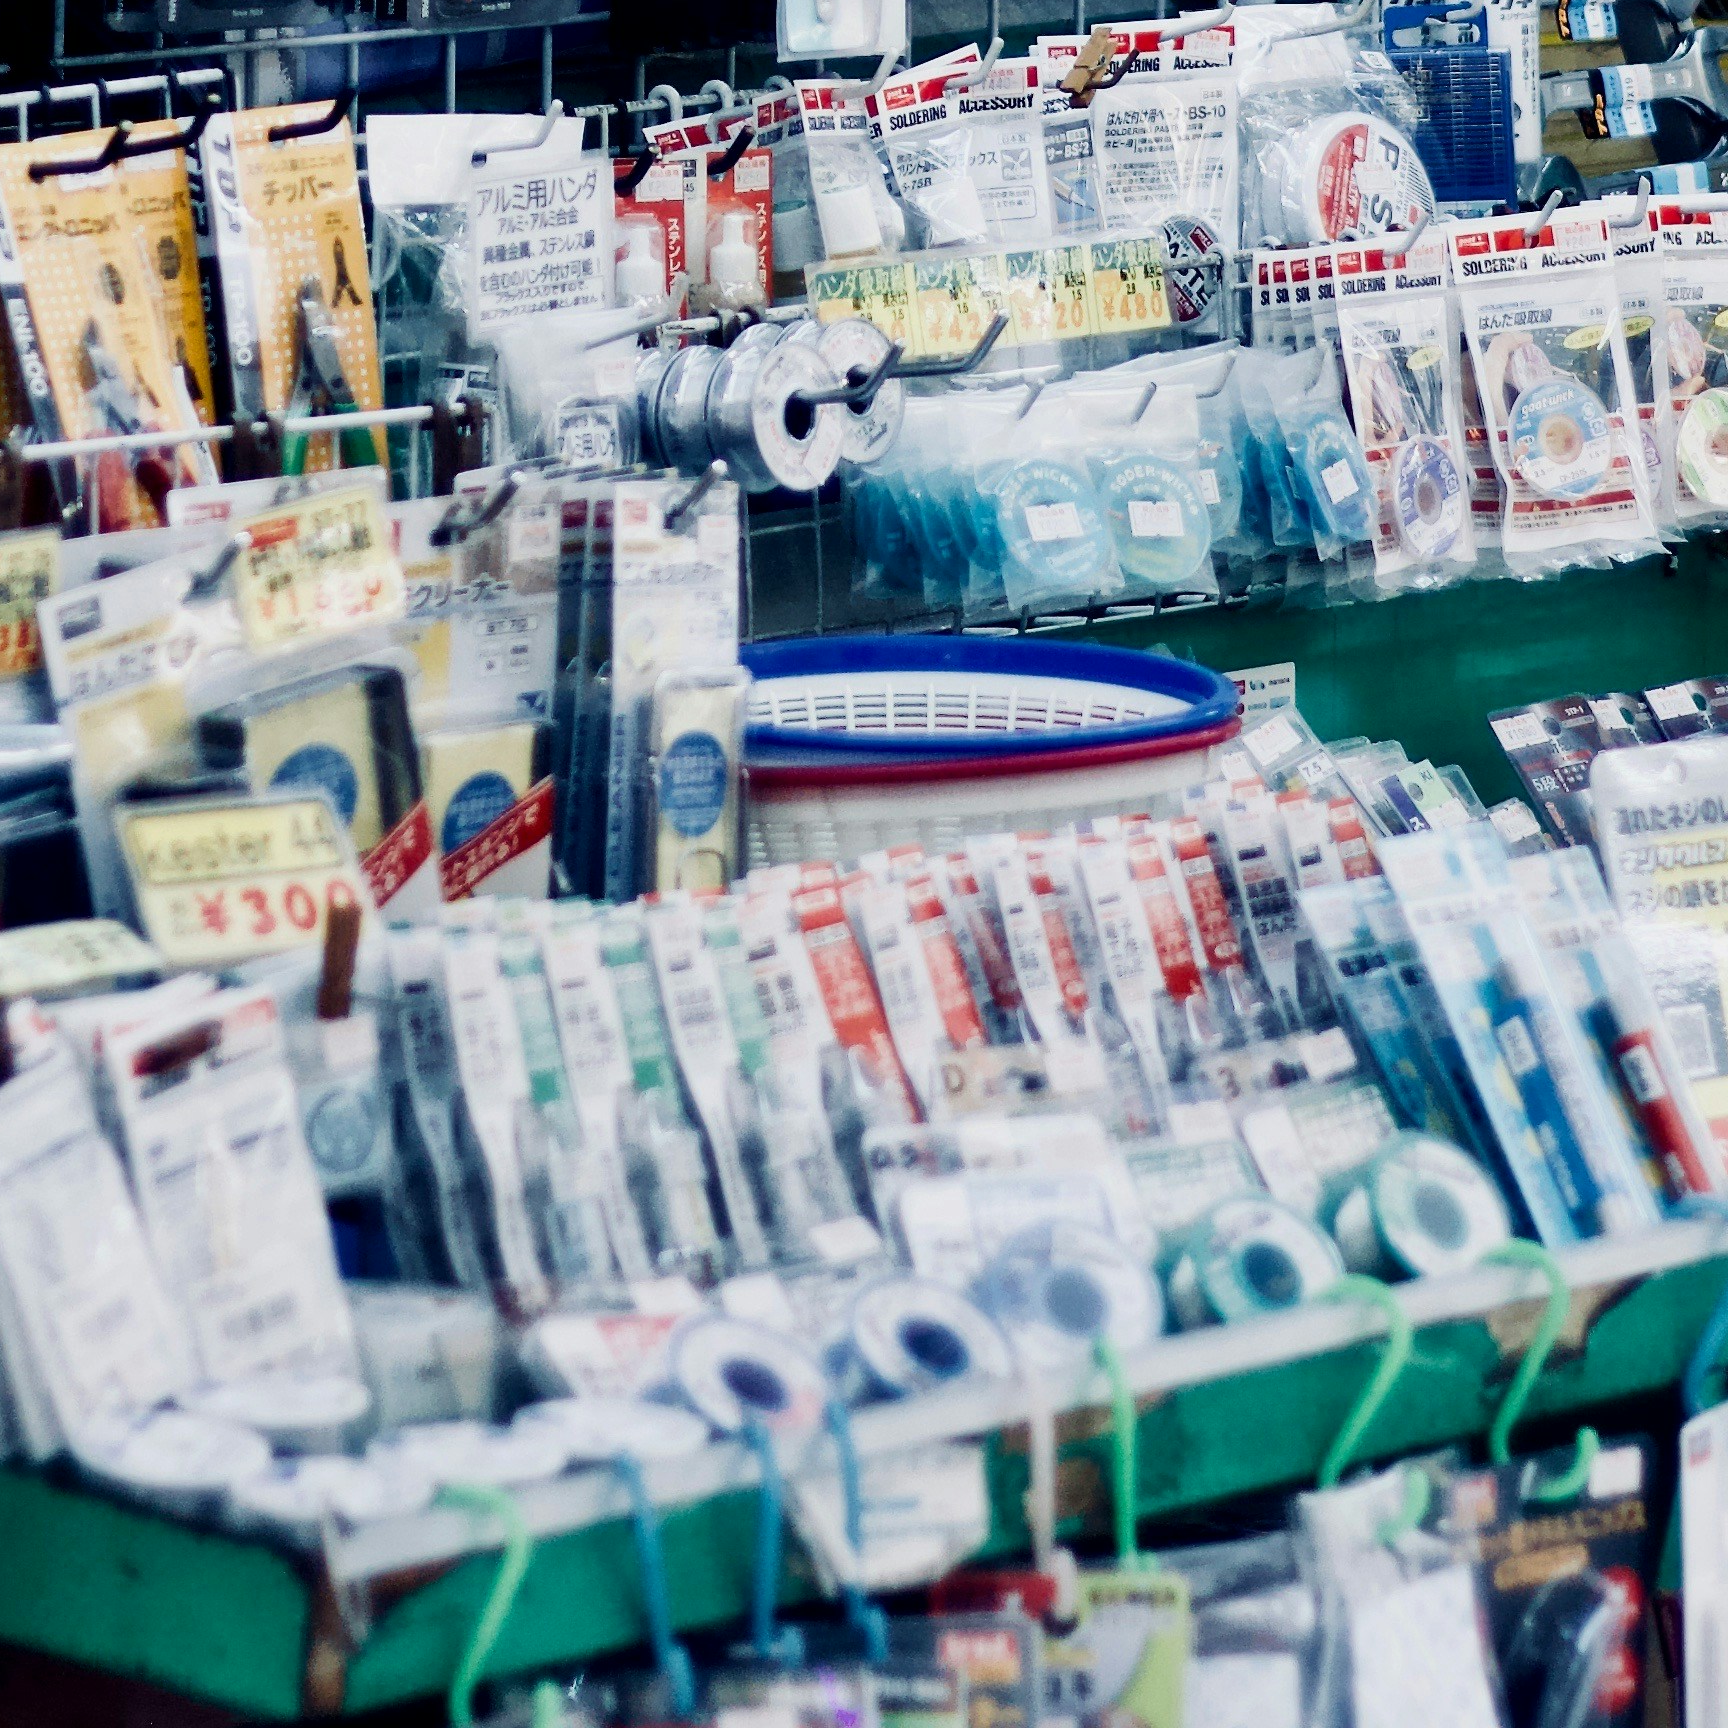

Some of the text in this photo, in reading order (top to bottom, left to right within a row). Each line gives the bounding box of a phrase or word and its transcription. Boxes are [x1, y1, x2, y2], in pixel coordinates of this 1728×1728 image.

[889, 105, 948, 130] SOLDERING
[1188, 105, 1227, 121] BS-10
[262, 177, 335, 202] チッパー
[476, 169, 598, 217] アルミ用ハンダ
[497, 206, 579, 236] アルミ・アルミ合金
[1462, 256, 1528, 277] SOLDERING
[1341, 276, 1386, 295] SOLDERING
[1103, 291, 1163, 321] ¥480
[1477, 309, 1553, 330] はんだ吸取線
[11, 298, 47, 400] ENL-100
